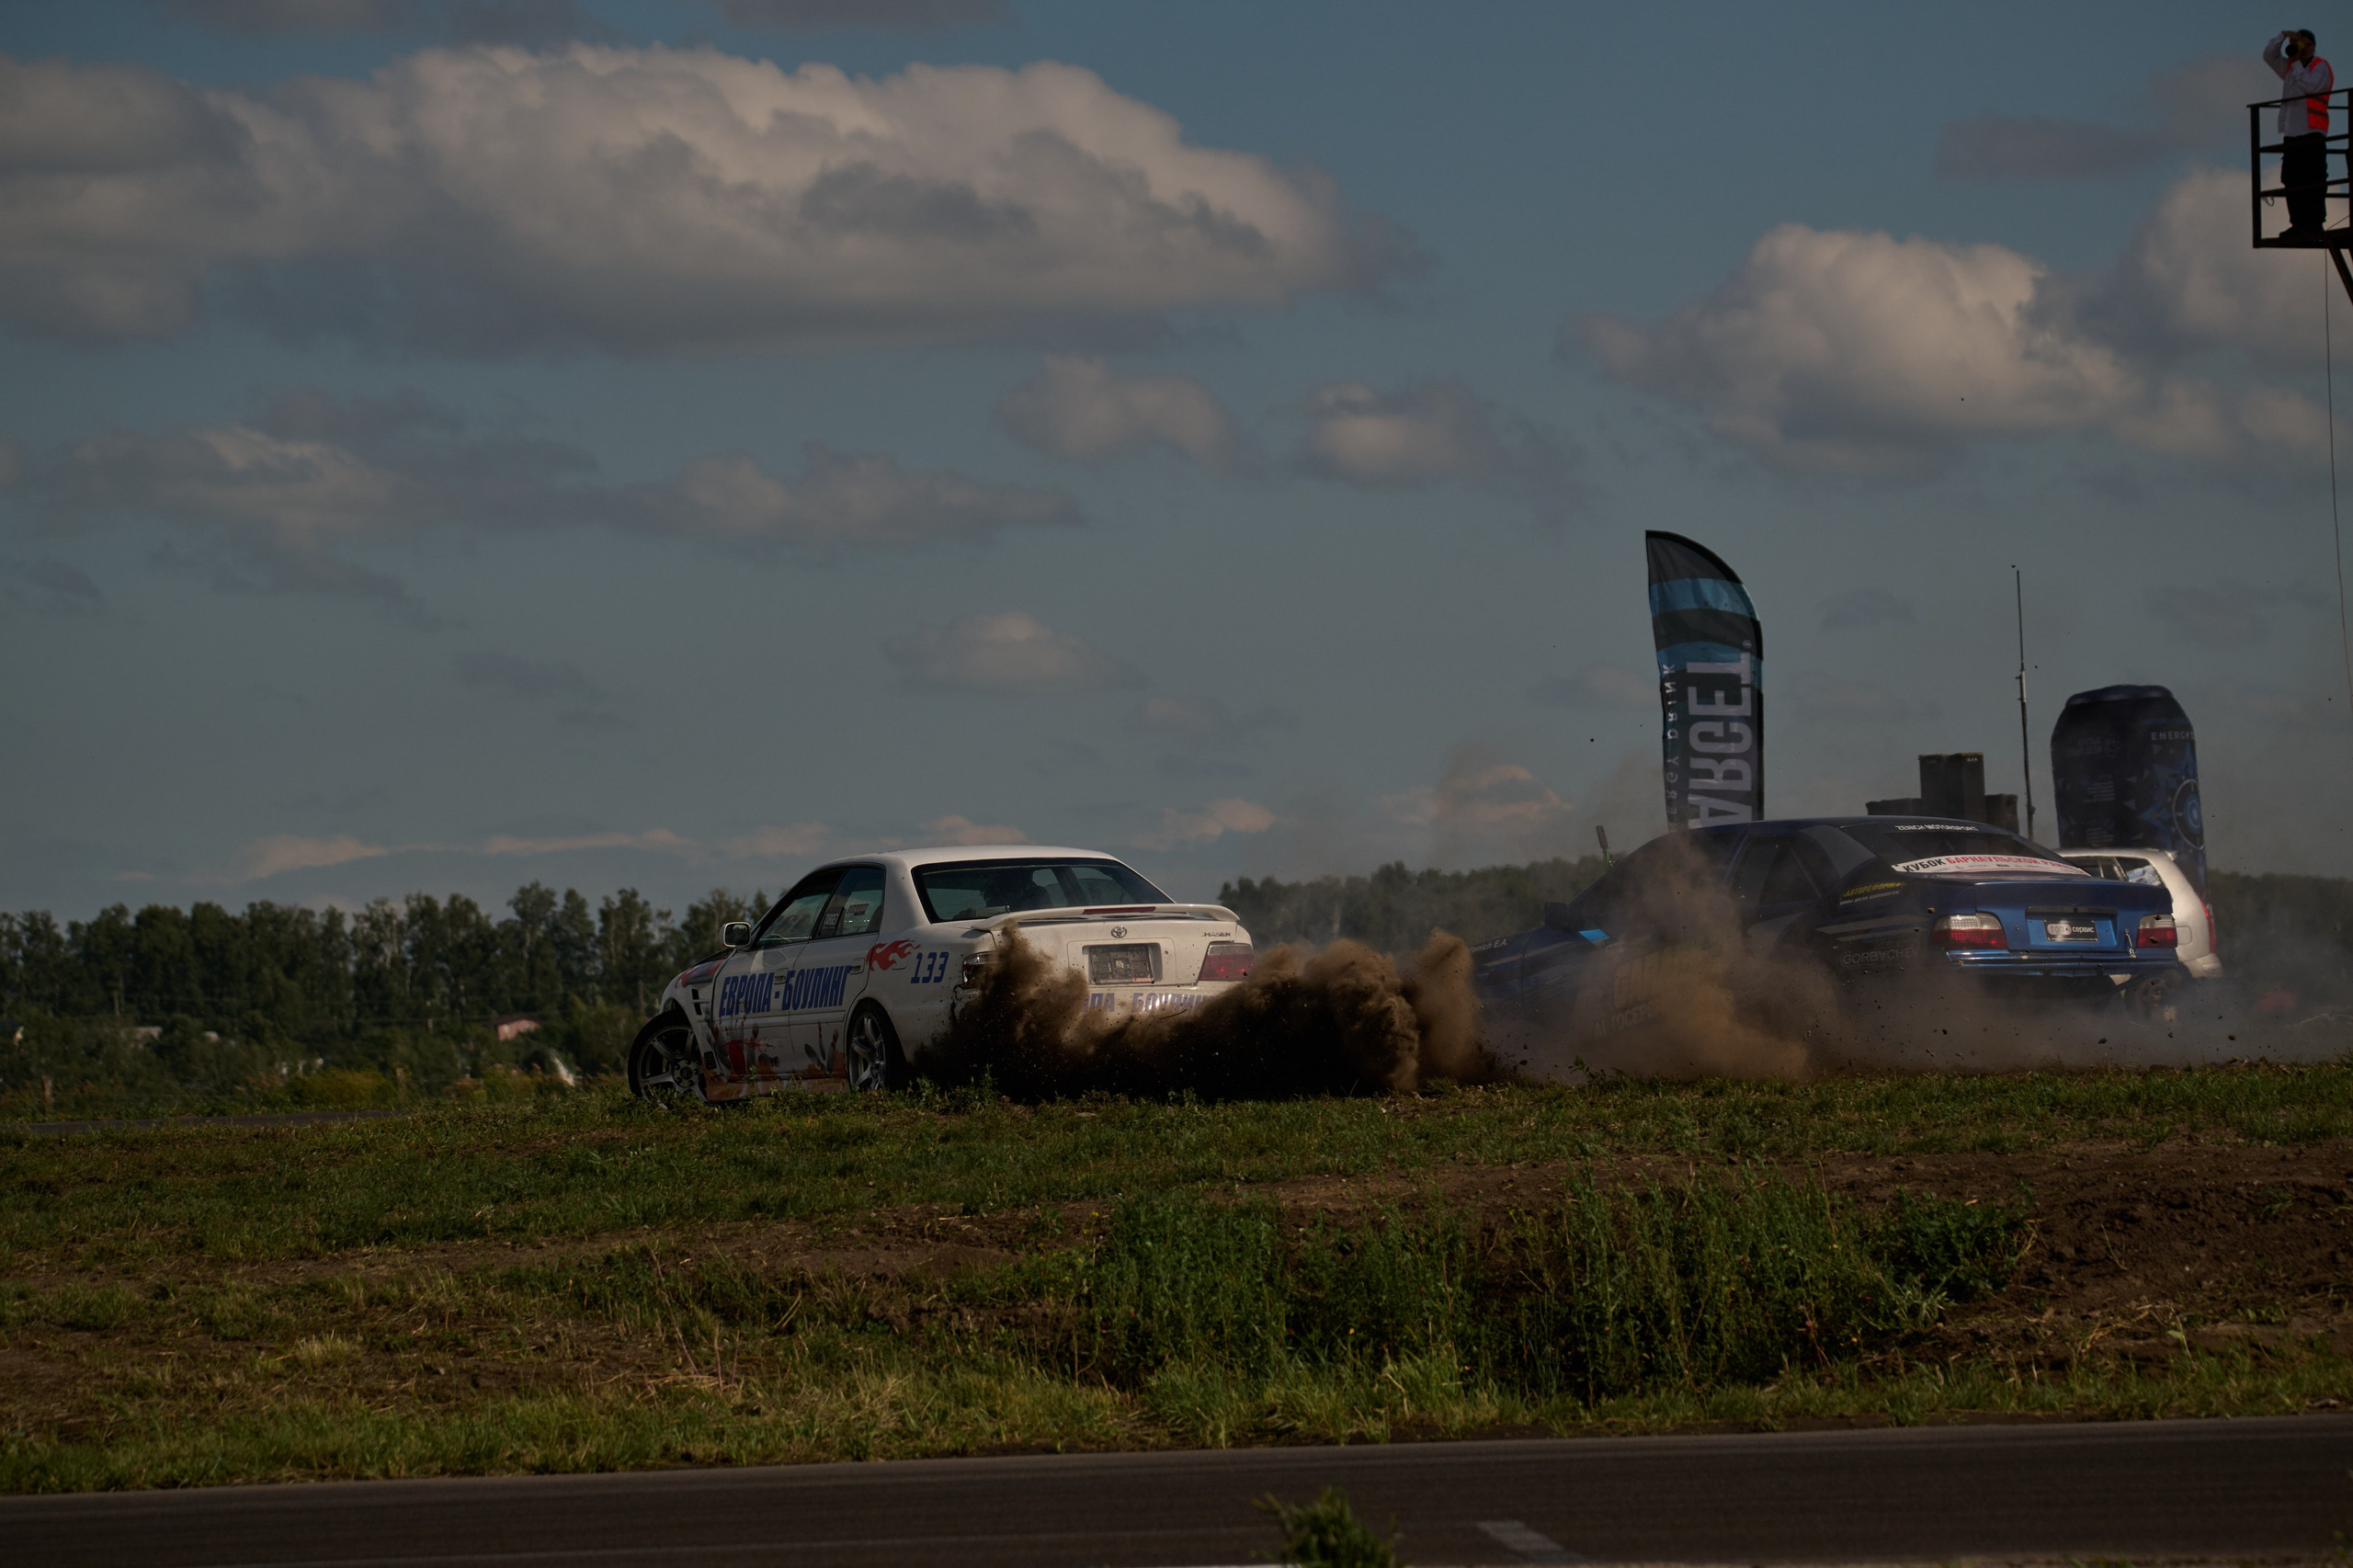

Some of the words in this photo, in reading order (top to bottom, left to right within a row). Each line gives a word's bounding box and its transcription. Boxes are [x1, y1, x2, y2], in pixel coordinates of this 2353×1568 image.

[1903, 858, 1947, 873] КУБОК
[1945, 856, 2042, 866] БАРНАУЛЬСКОЙ
[911, 951, 949, 984] 133
